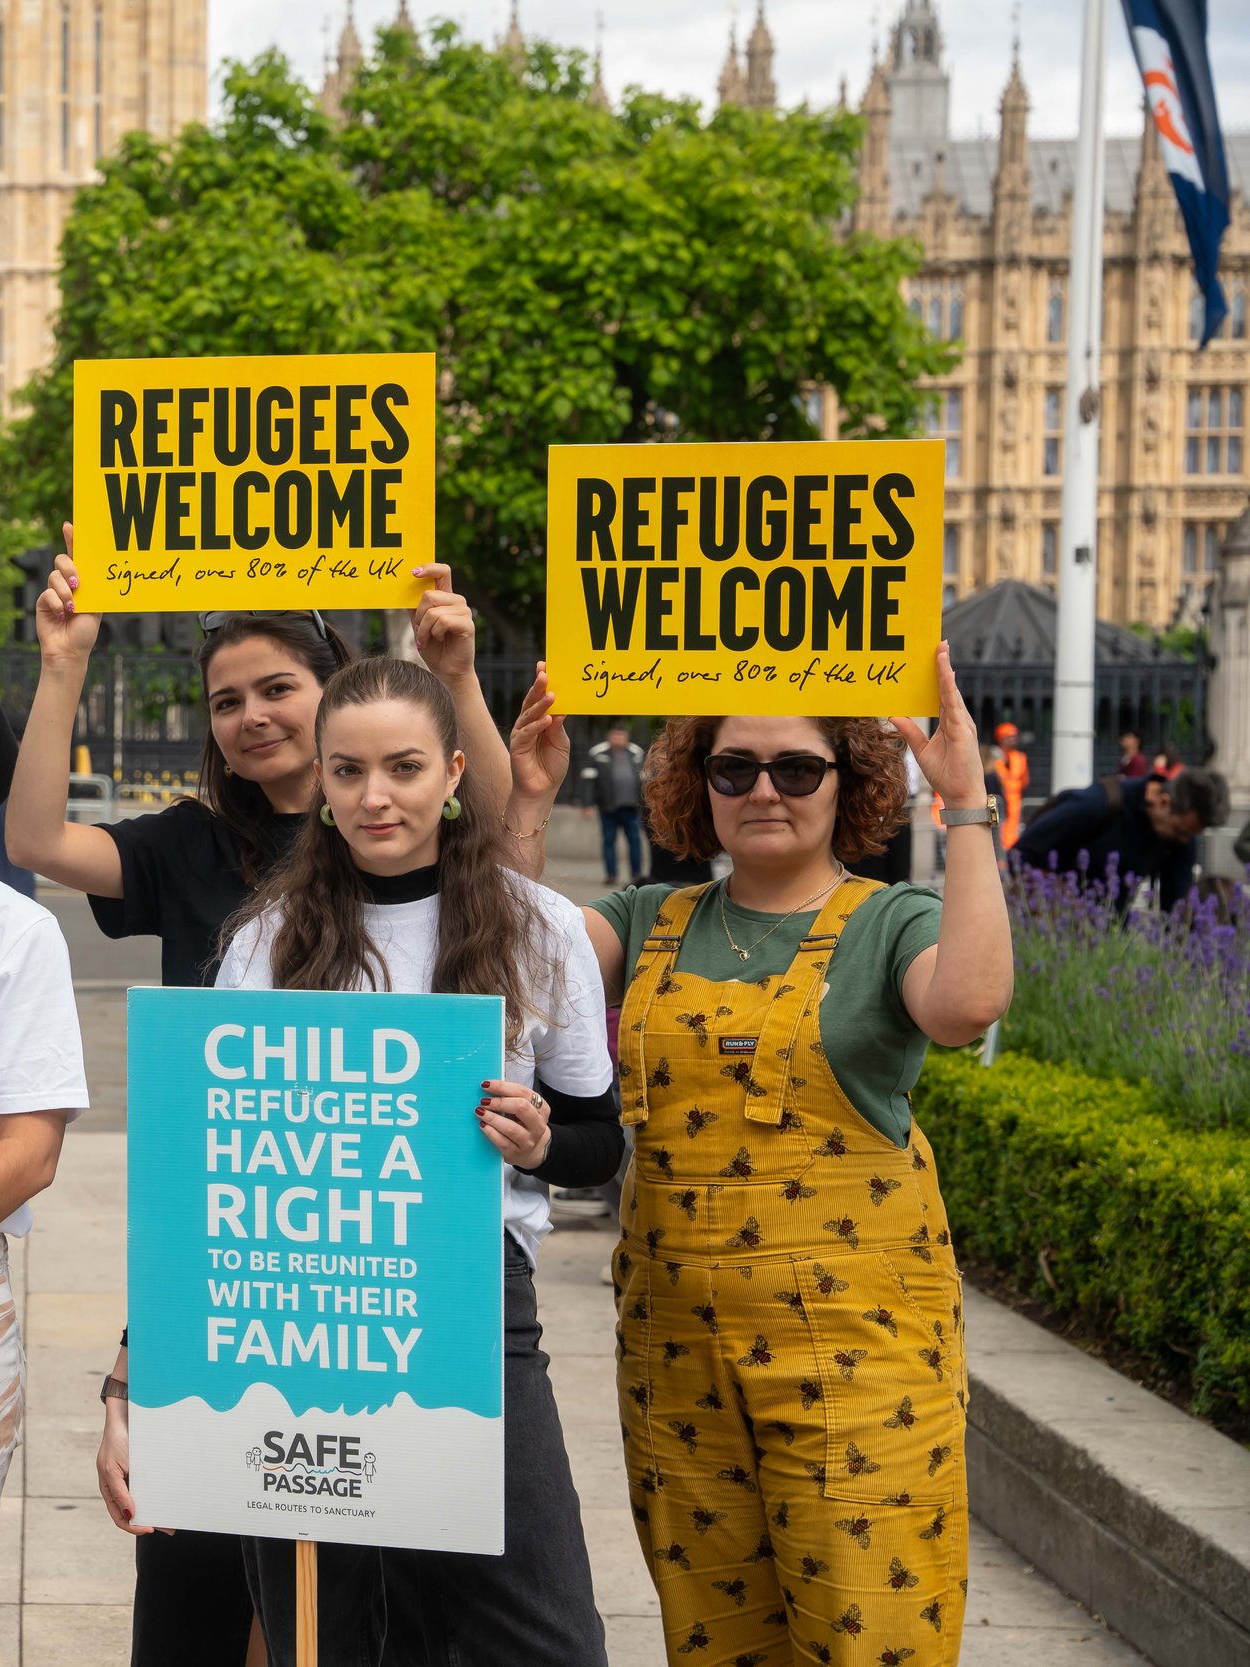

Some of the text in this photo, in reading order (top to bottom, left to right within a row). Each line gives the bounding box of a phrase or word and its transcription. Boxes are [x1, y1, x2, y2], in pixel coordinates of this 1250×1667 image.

[101, 383, 409, 467] REFUGEES
[105, 469, 402, 551] WELCOME
[576, 473, 915, 561] REFUGEES
[195, 569, 236, 580] over
[247, 558, 287, 578] 80%
[298, 555, 326, 586] of
[329, 560, 358, 578] the
[369, 558, 404, 579] UK
[581, 566, 906, 651] WELCOME
[677, 672, 722, 682] over
[734, 660, 777, 681] 80%
[789, 658, 820, 691] of
[824, 664, 856, 683] the
[867, 662, 906, 685] UK
[205, 1024, 420, 1084] CHILD
[208, 1088, 418, 1126] REFUGEES
[207, 1129, 422, 1180] HAVE A
[208, 1184, 422, 1245] RIGHT
[208, 1249, 417, 1278] TO BE REUNITED
[208, 1279, 417, 1316] WITH THEIR
[208, 1317, 422, 1373] FAMILY
[264, 1431, 361, 1469] SAFE
[264, 1473, 362, 1498] PASSAGE
[247, 1501, 375, 1518] LEGAL ROUTES TO SANCTUARY
